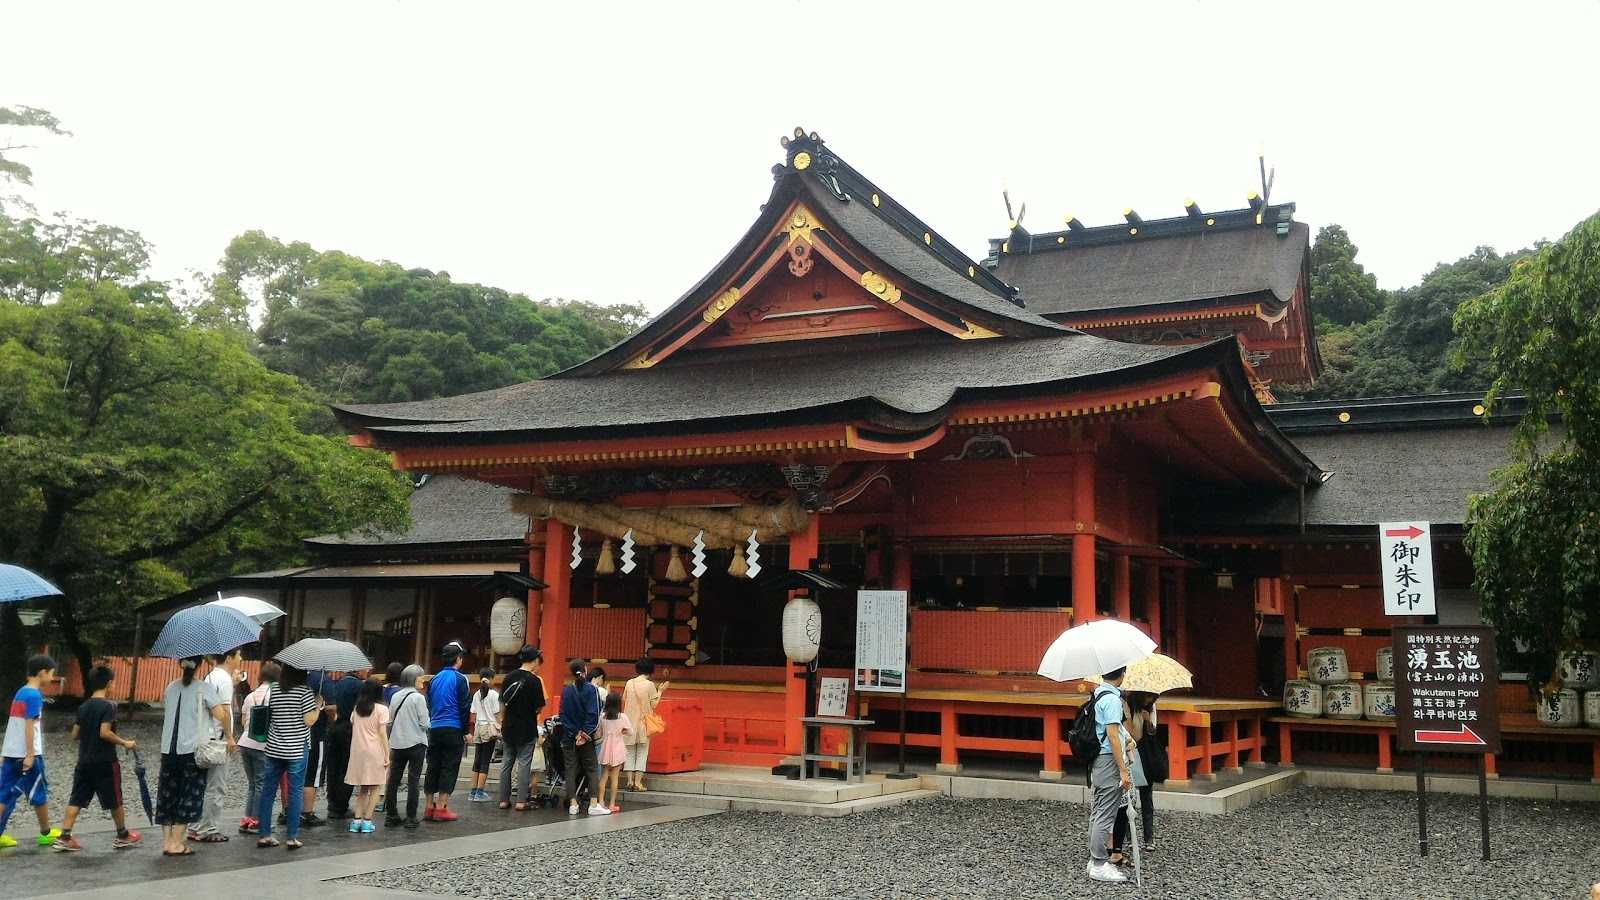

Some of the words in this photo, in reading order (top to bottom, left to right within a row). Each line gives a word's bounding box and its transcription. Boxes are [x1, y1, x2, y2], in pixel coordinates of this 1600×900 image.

[1390, 540, 1422, 611] 御朱印
[1407, 634, 1480, 645] 国特別天然記念物
[1407, 648, 1481, 671] 湧玉池
[1412, 688, 1456, 697] Wakutama
[1457, 689, 1479, 698] Pond
